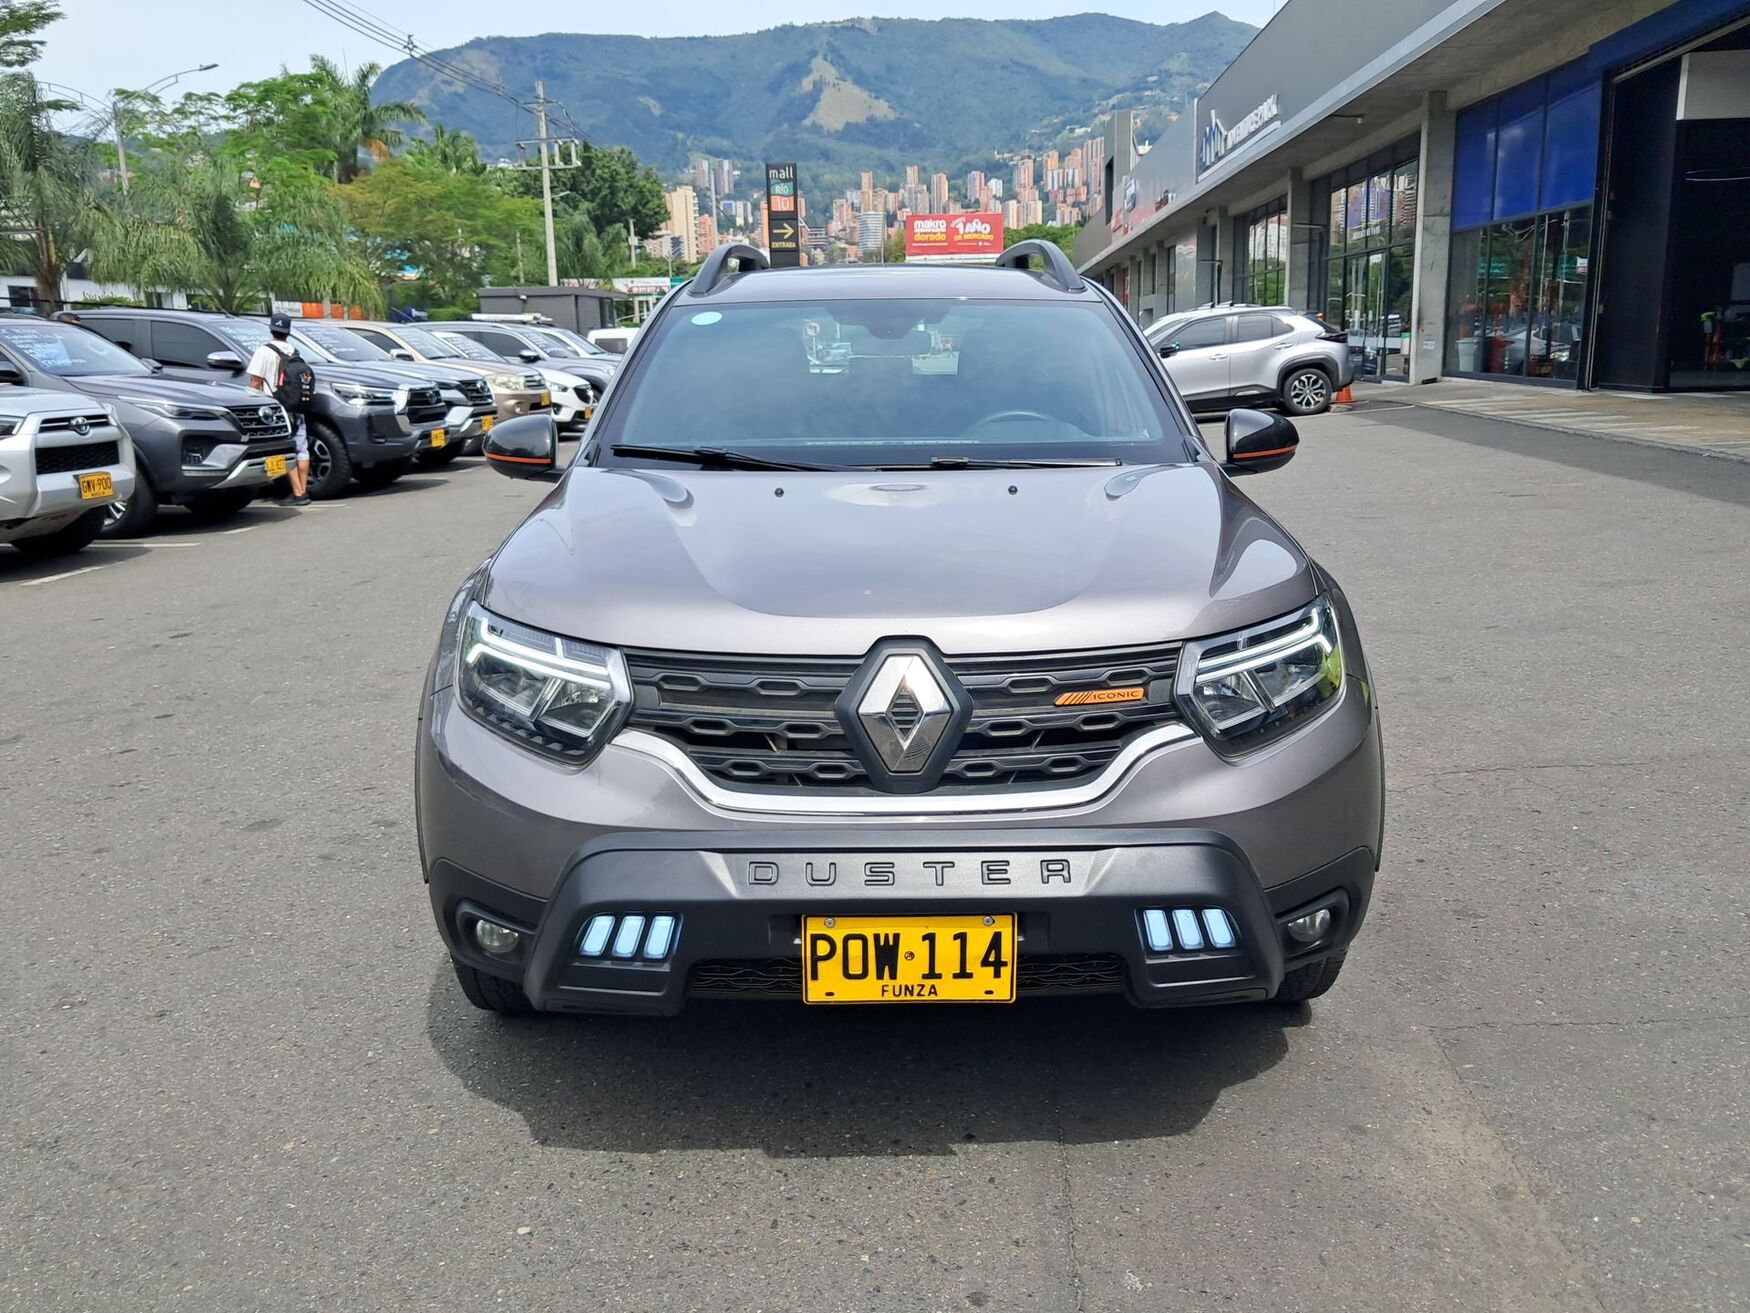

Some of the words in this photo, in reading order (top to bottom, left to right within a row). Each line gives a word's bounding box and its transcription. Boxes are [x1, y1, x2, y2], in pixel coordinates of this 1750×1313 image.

[769, 166, 793, 179] mall
[776, 198, 790, 209] 10
[913, 218, 947, 229] makro
[914, 232, 946, 242] dorado
[771, 241, 797, 249] ENTRADA
[1092, 690, 1140, 700] ICONIC
[748, 859, 1072, 887] DUSTER
[809, 932, 900, 981] POW
[921, 931, 1008, 980] 114
[881, 983, 938, 997] FUNZA
